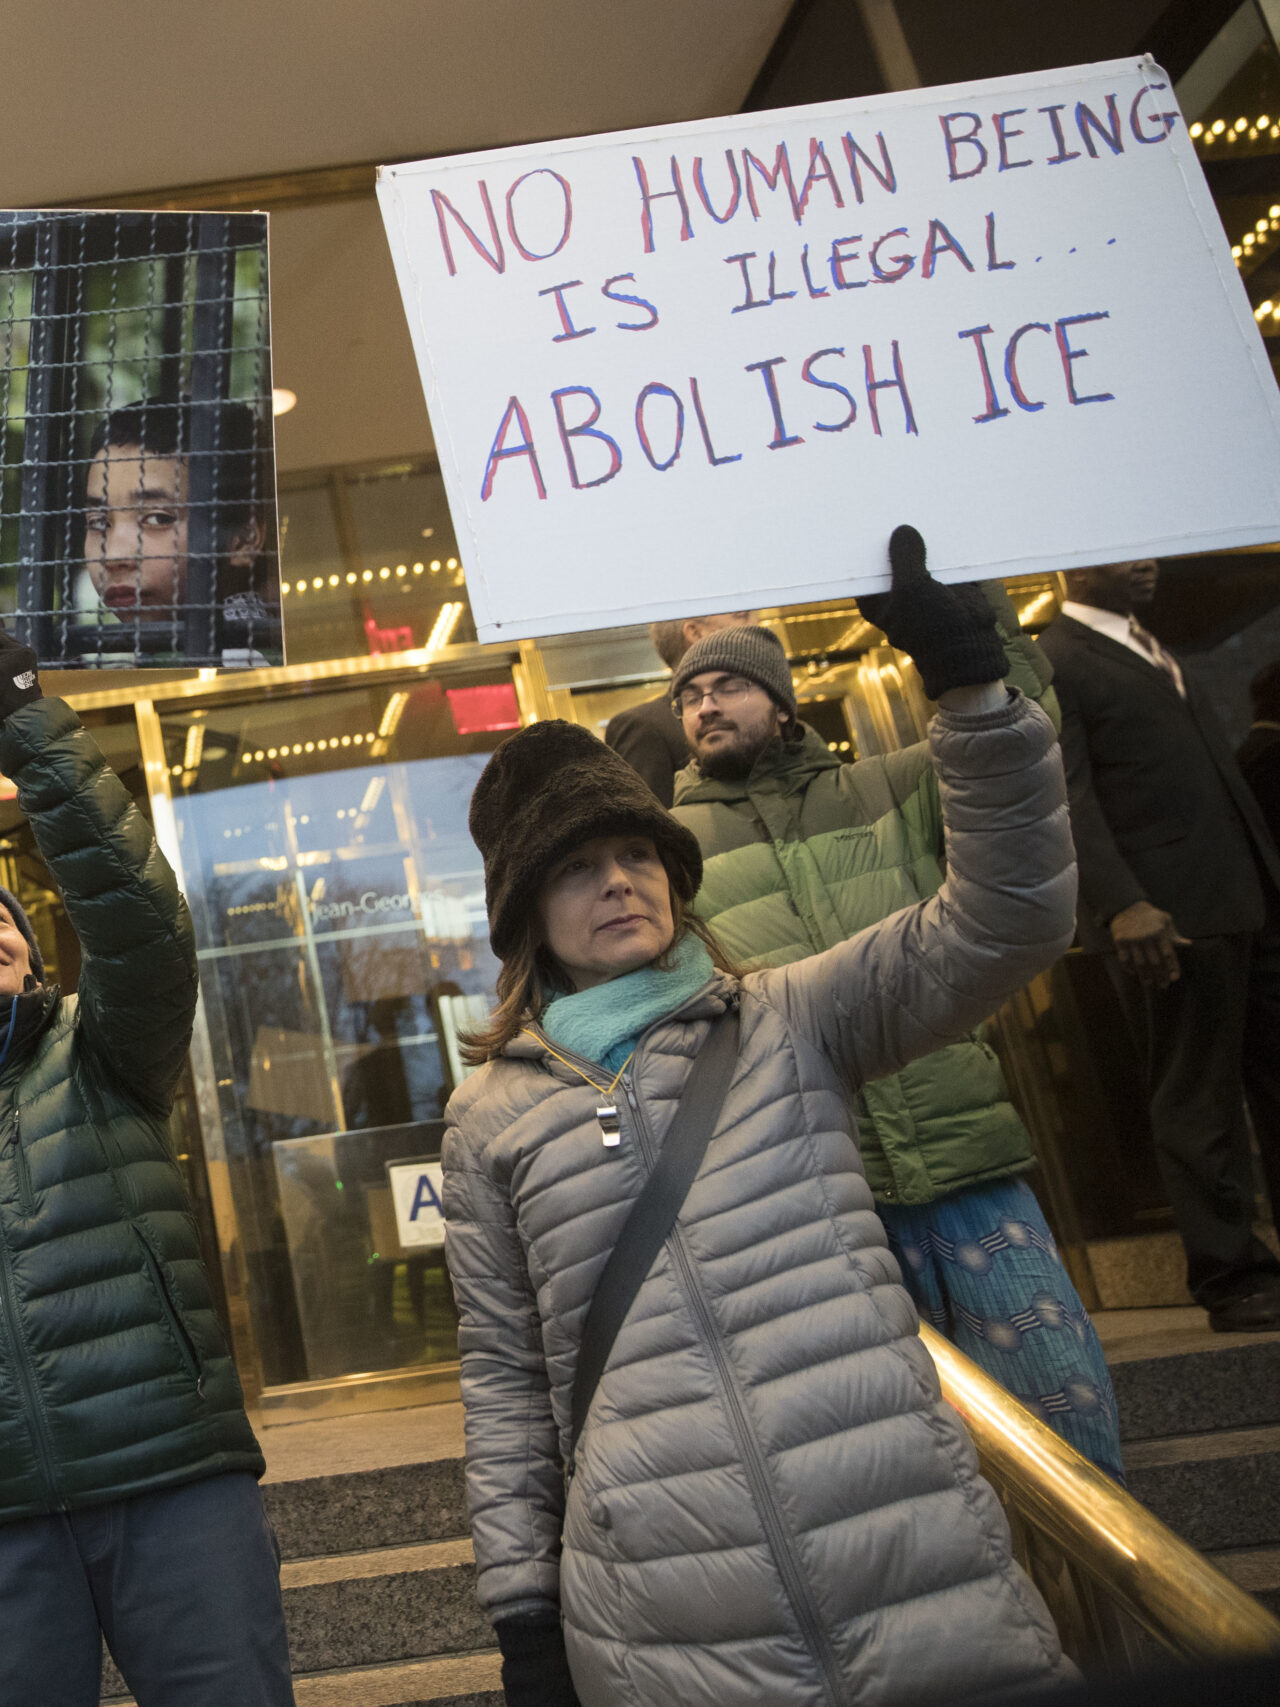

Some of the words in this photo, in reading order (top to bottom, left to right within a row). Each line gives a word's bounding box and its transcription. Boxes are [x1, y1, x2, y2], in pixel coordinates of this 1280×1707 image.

[430, 168, 573, 277] NO
[632, 131, 898, 254] HUMAN
[939, 84, 1180, 183] BEING
[539, 273, 660, 344] IS
[480, 340, 920, 502] ABOLISH
[958, 310, 1117, 424] ICE
[310, 889, 442, 926] Jean-Geores
[409, 1174, 446, 1222] A
